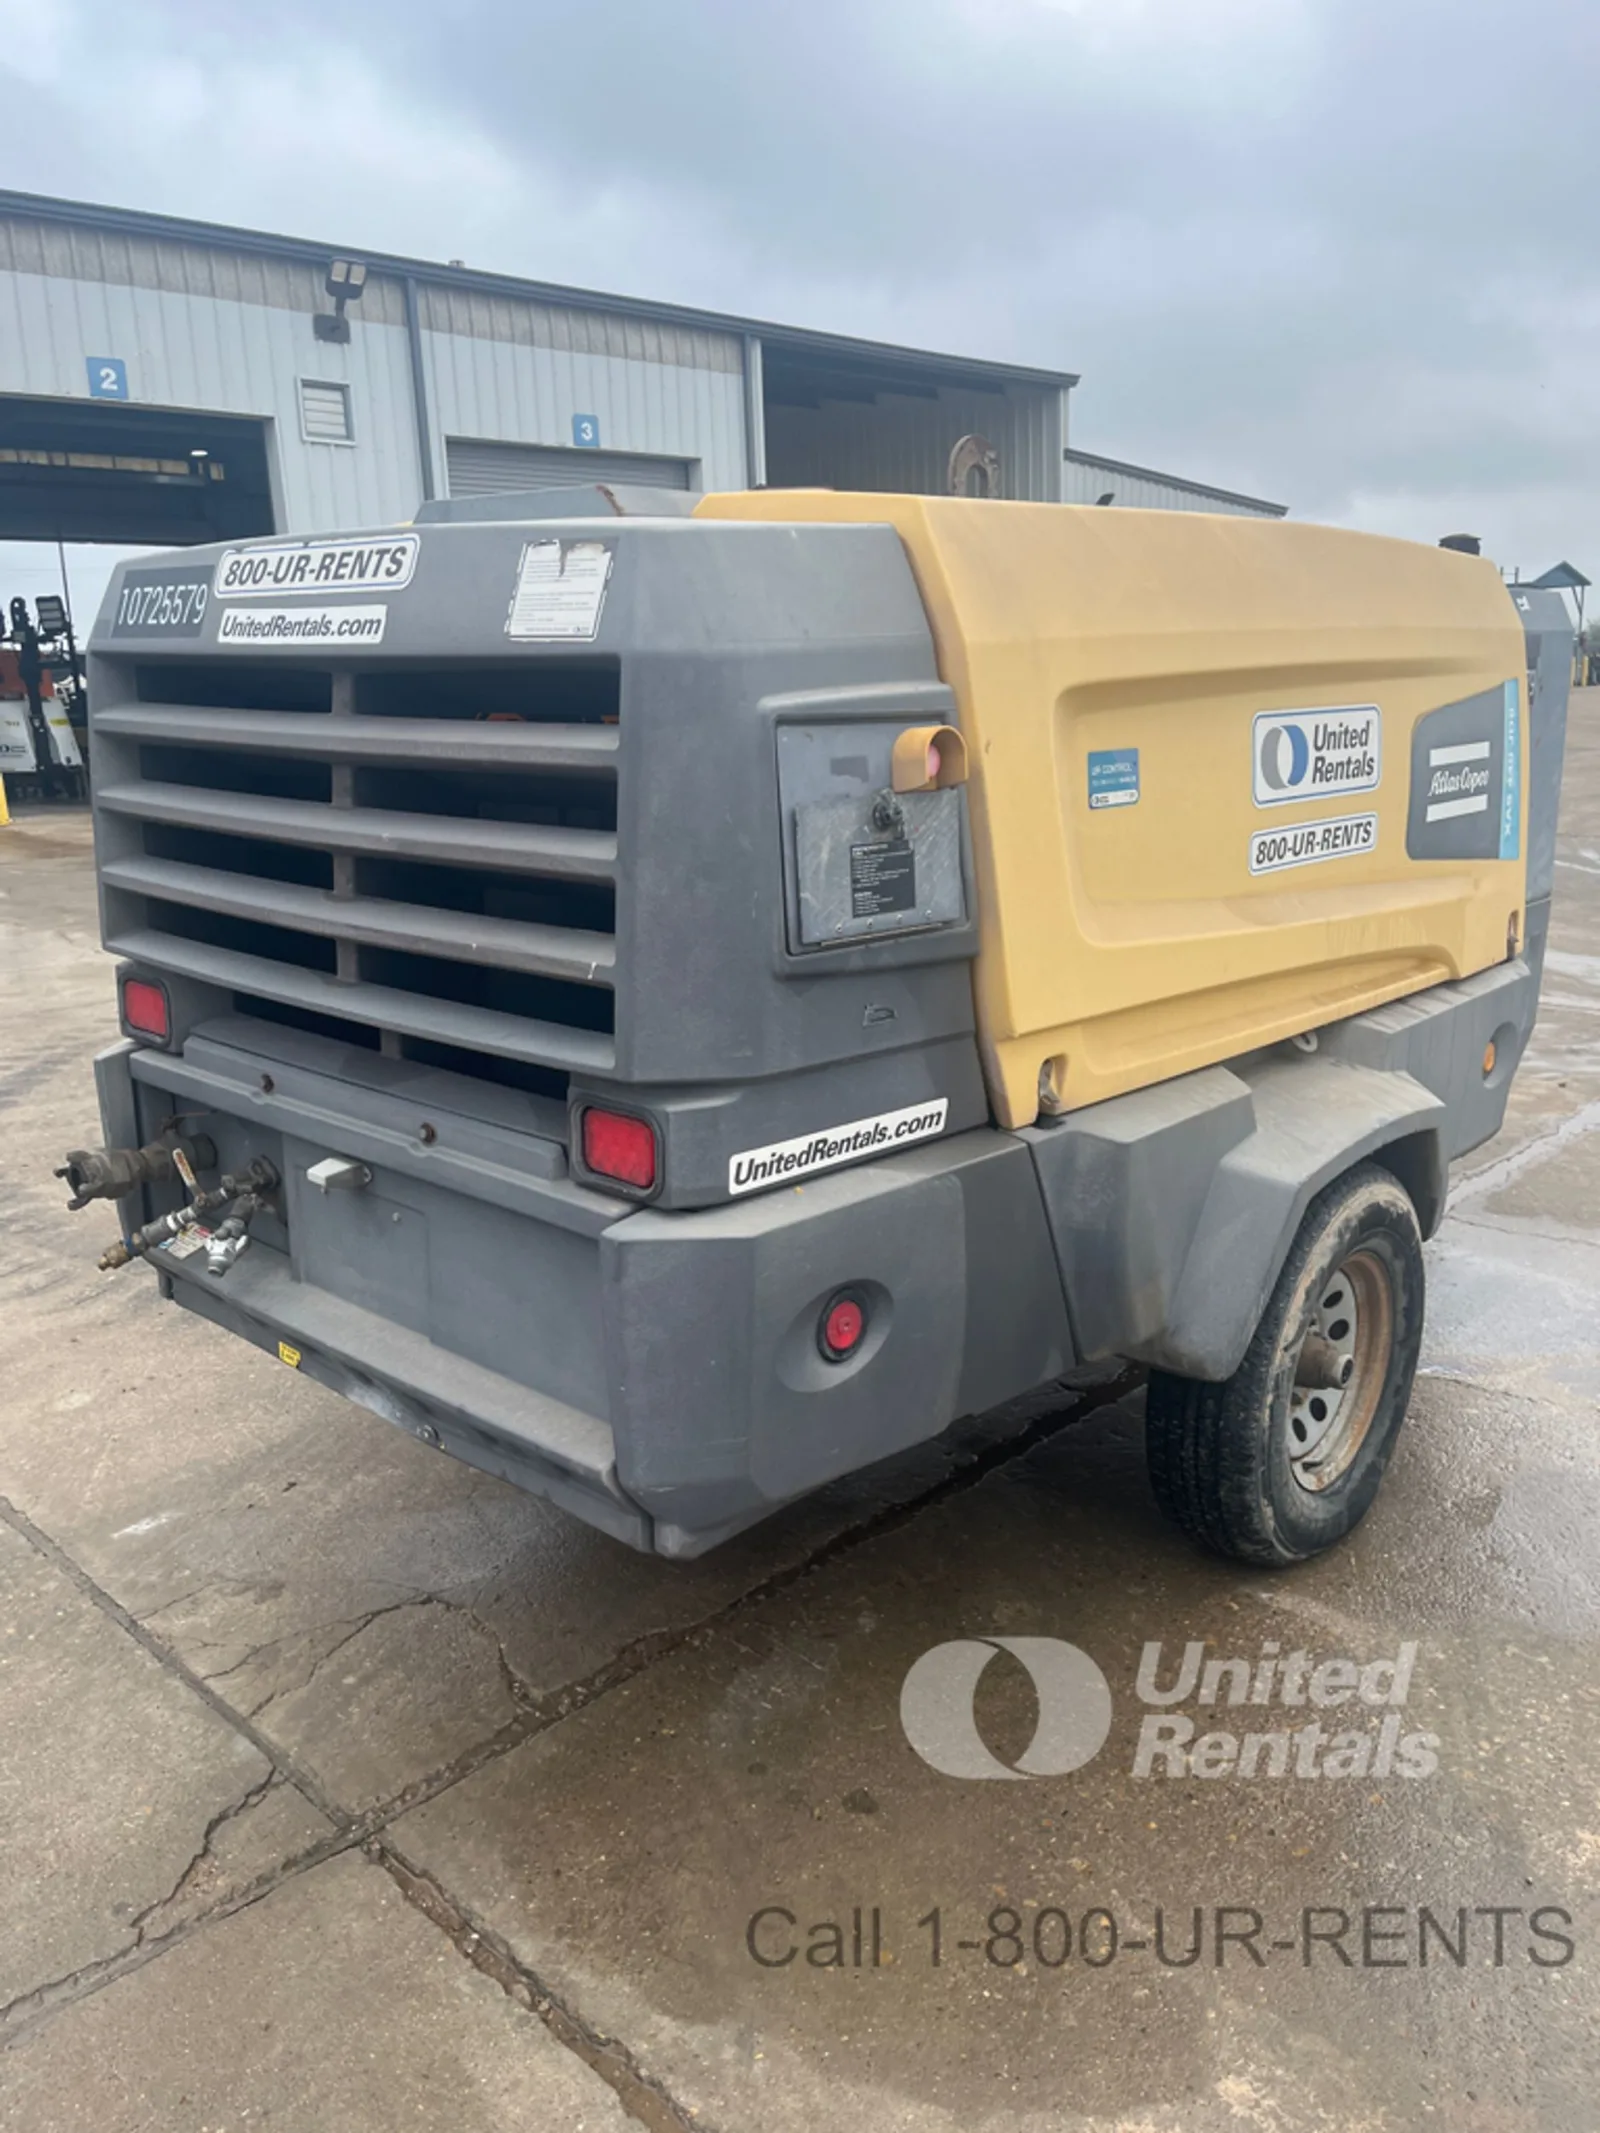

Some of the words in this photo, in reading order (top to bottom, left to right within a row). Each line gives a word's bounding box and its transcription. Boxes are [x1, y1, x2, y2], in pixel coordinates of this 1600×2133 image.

[100, 367, 118, 391] 2
[581, 421, 593, 441] 3
[224, 546, 407, 587] 800-UR-RENTS
[118, 583, 208, 626] 10725579
[222, 613, 381, 637] UnitedRentals.com
[1313, 720, 1370, 752] United
[1312, 751, 1375, 784] Rentals
[1256, 820, 1373, 865] 800-UR-RENTS
[734, 1110, 942, 1186] UnitedRentals.com
